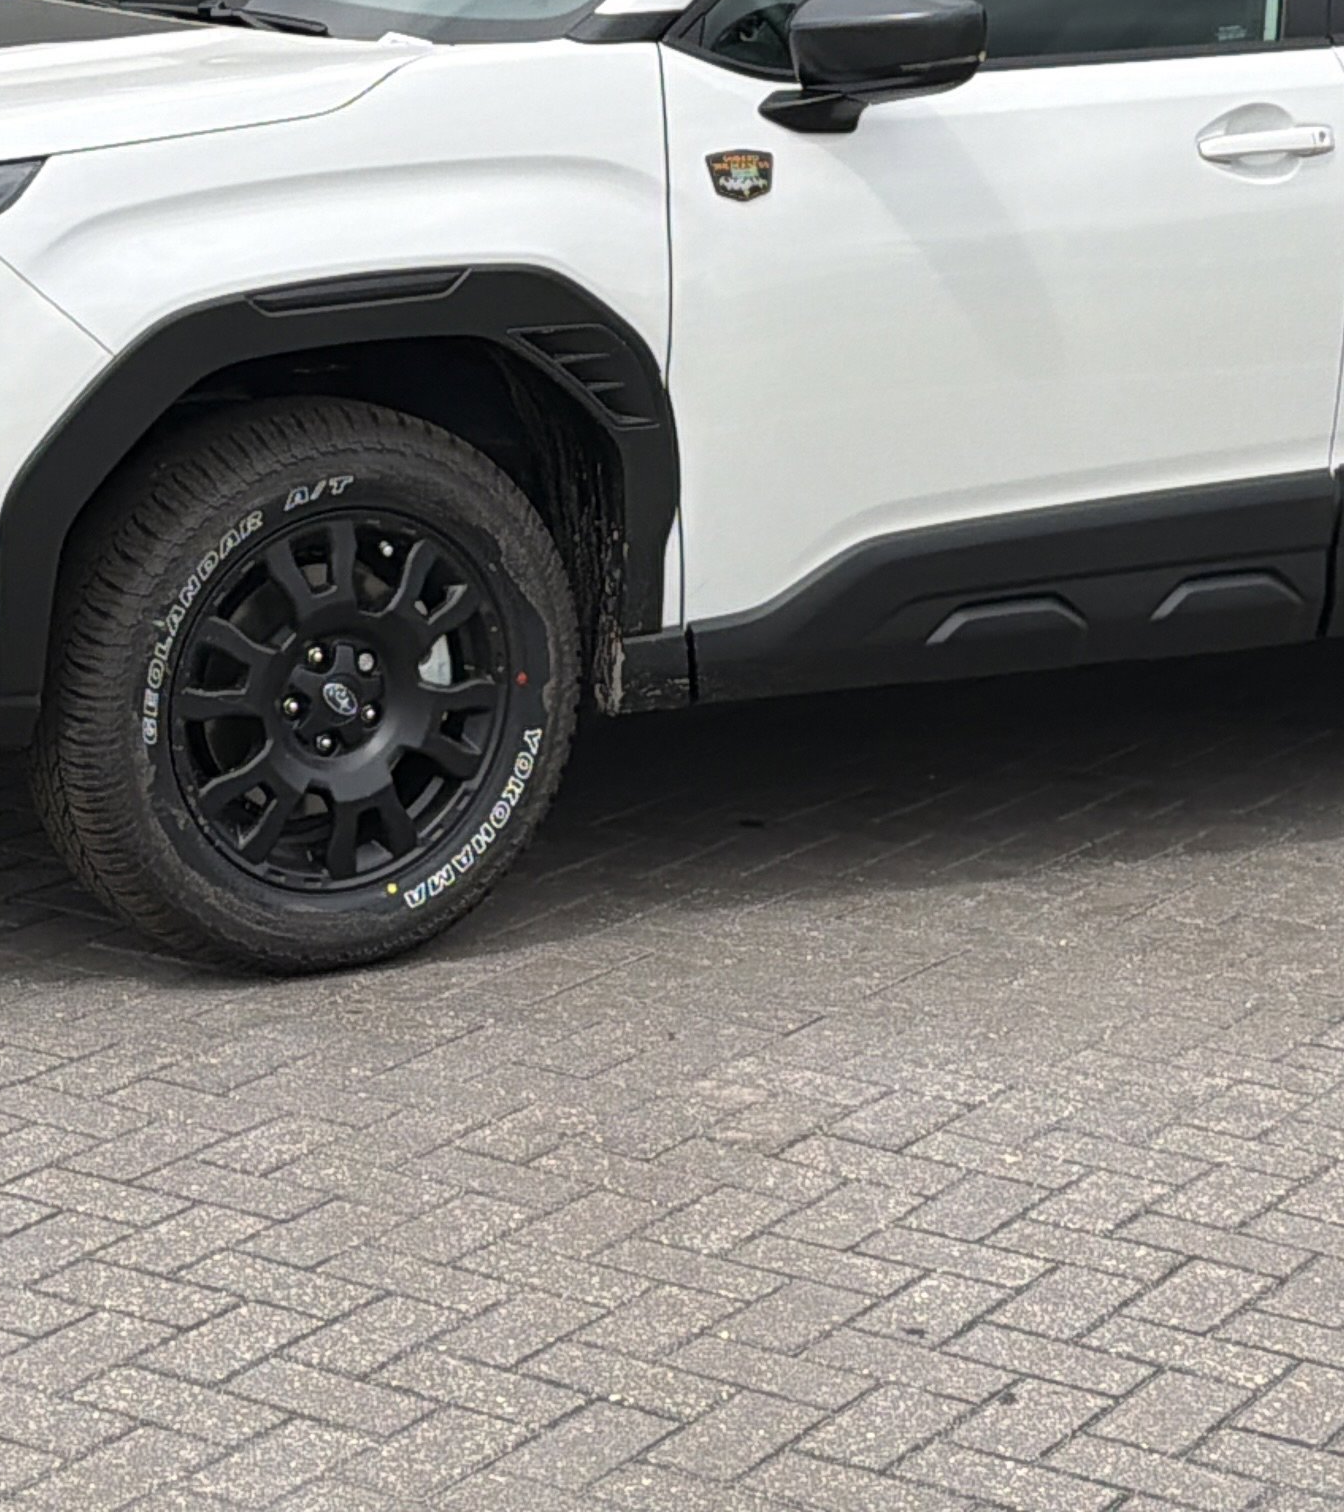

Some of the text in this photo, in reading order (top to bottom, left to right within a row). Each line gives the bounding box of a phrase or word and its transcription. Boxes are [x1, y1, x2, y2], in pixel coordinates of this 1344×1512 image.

[142, 475, 354, 745] GEOLANDAR A/T
[404, 728, 543, 908] YOKOHAMA
